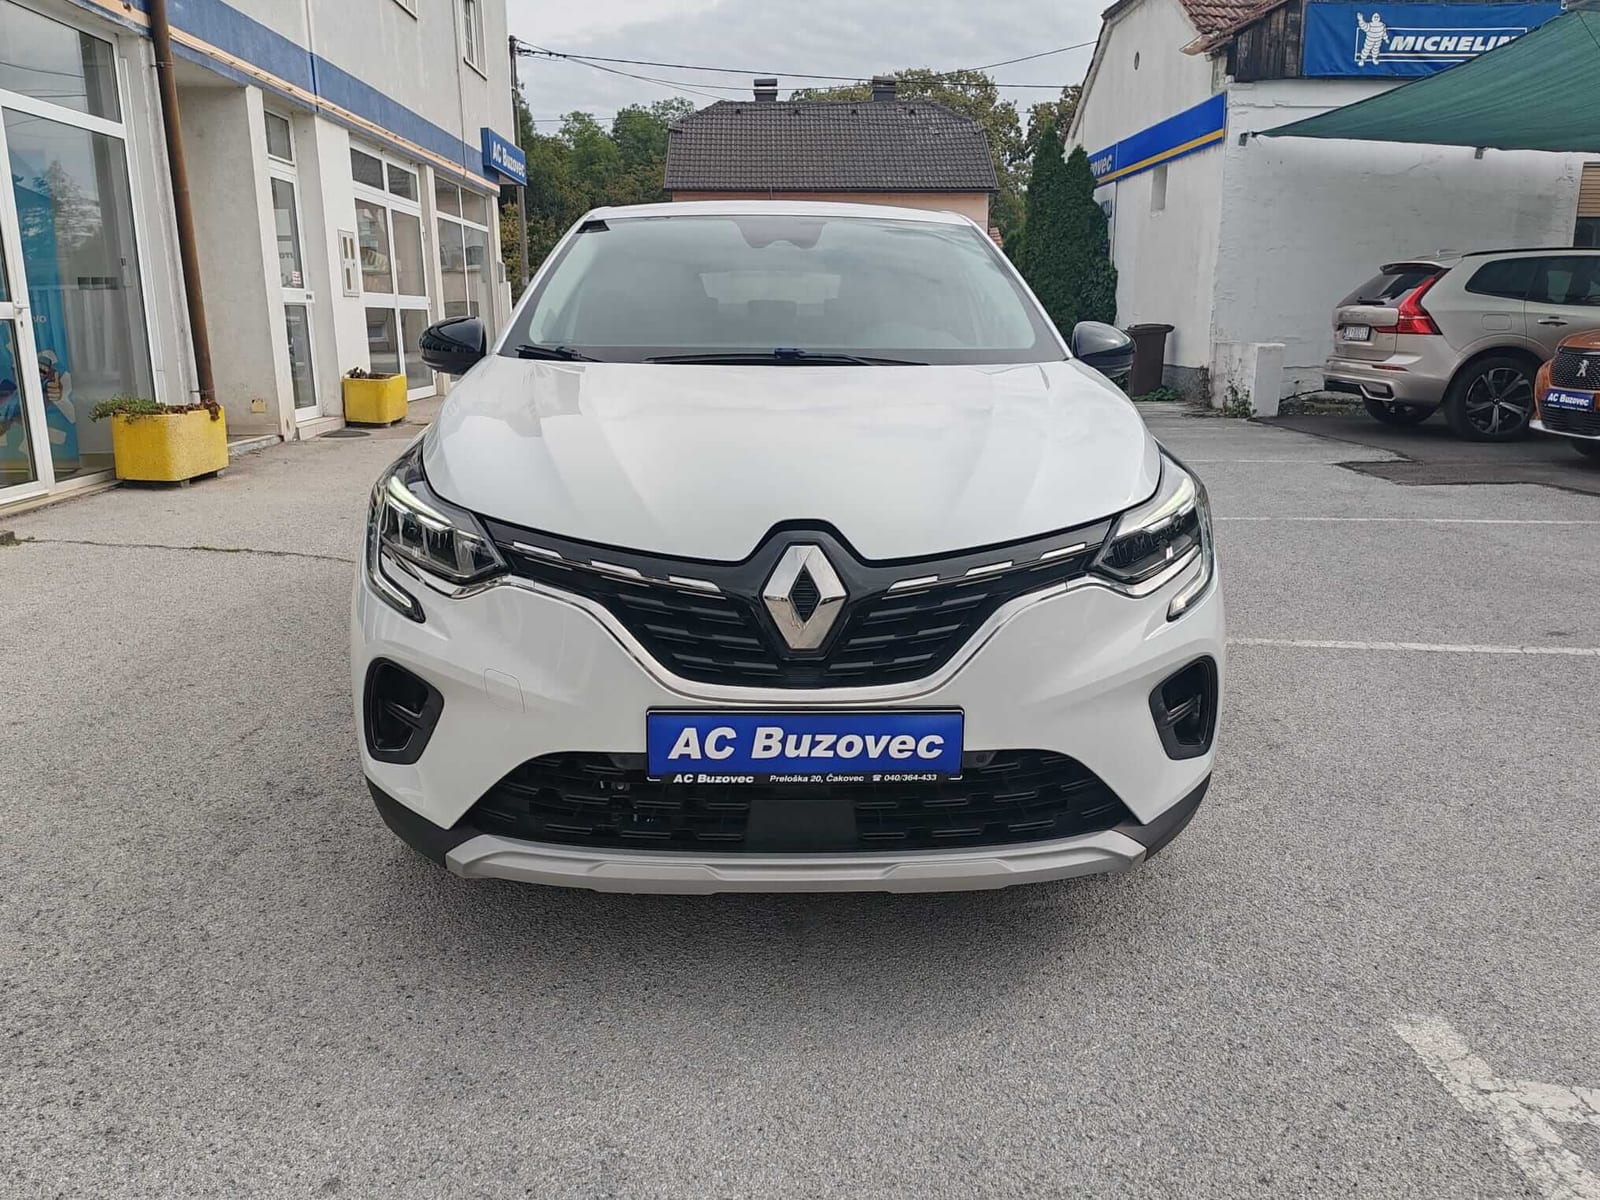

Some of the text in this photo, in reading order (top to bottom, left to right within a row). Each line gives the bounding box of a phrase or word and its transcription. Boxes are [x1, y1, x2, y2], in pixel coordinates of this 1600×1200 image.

[492, 140, 525, 178] AC Buzovec
[1547, 393, 1590, 406] AC Buzovec
[667, 726, 945, 760] AC Buzovec
[673, 772, 937, 783] AC Buzovec Preloška 20, Čakovec 040/364-433
